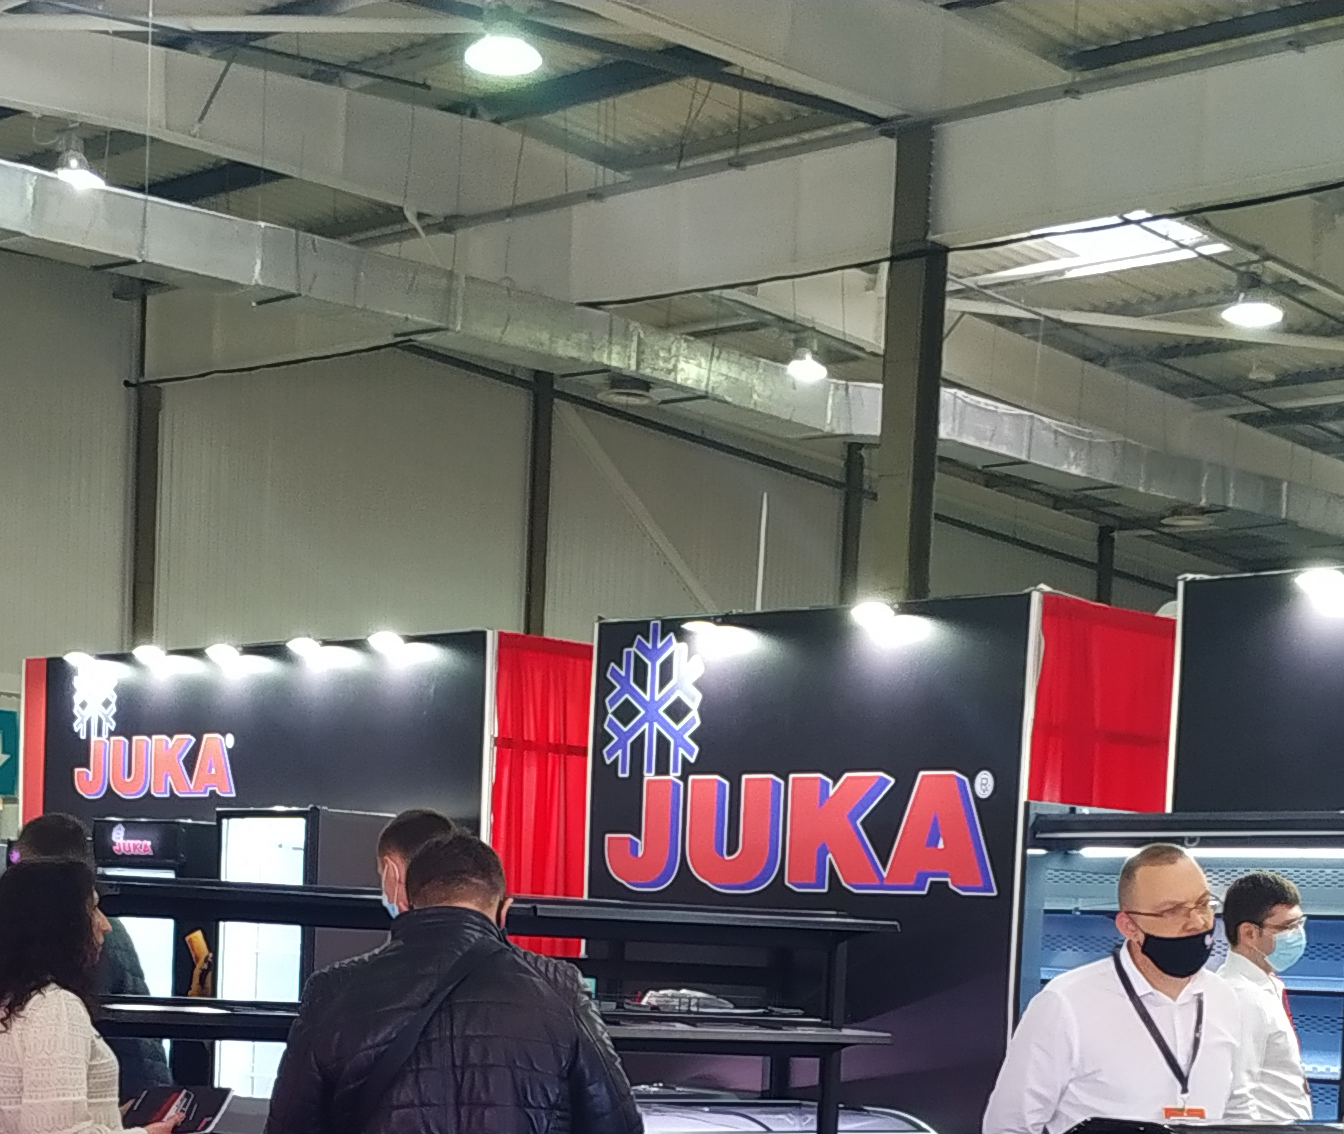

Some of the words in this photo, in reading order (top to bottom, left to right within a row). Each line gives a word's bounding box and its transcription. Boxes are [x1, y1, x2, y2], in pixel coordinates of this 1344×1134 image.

[74, 733, 237, 799] JUKA
[112, 839, 154, 856] JUKA
[604, 770, 998, 897] JUKA
